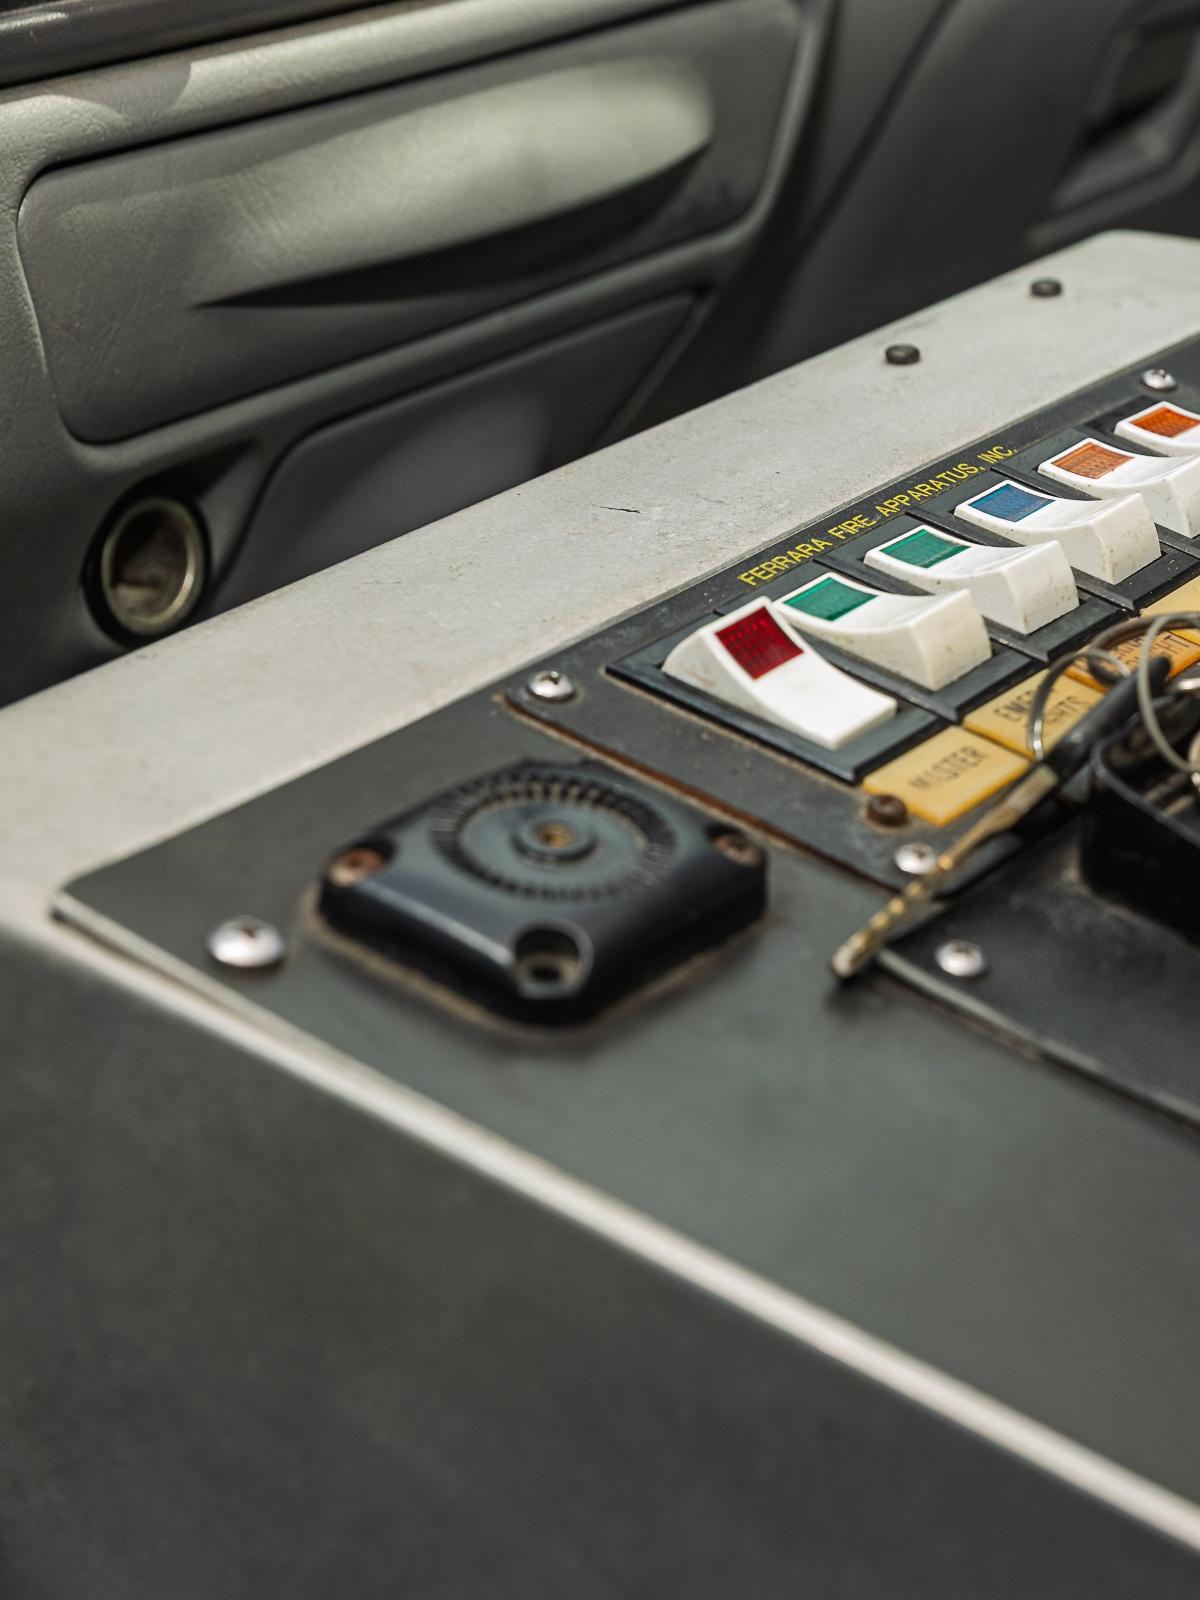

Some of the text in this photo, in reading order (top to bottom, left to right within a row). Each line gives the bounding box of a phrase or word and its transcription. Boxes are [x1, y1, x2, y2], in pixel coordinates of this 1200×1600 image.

[737, 445, 1019, 586] FERRARA FIRE APPARATUS, INC.
